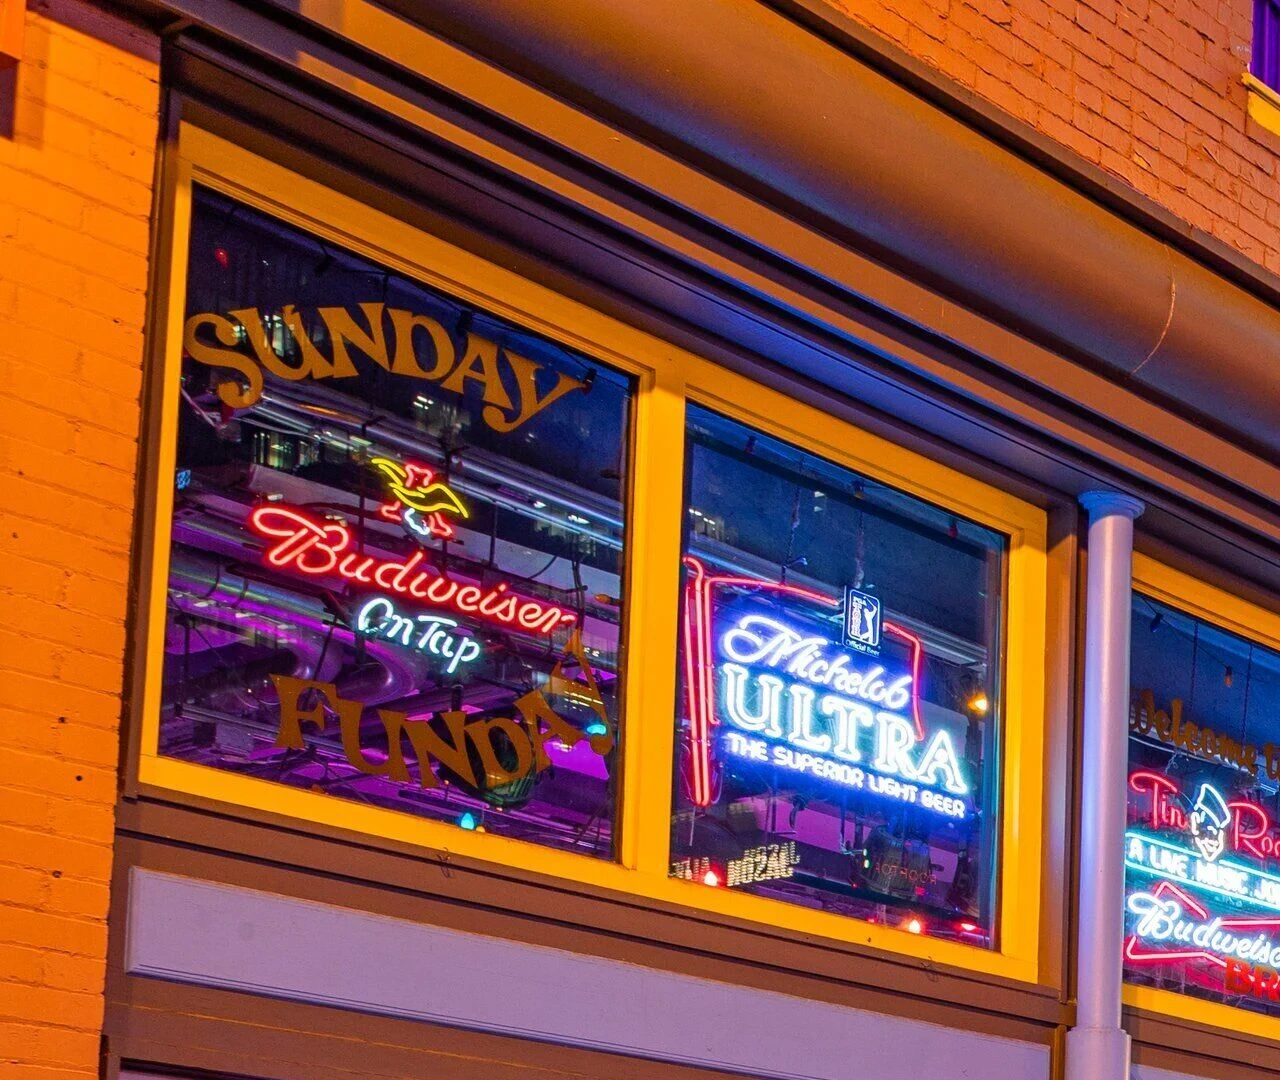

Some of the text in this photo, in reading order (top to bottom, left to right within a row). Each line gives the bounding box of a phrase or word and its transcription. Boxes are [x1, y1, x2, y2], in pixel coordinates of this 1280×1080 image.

[184, 302, 592, 432] SUNDAY
[252, 505, 576, 634] Budweiser
[403, 612, 481, 674] Tap
[723, 615, 912, 709] Michelob
[270, 629, 614, 791] FUNDAY
[722, 663, 969, 794] ULTRA
[728, 732, 967, 819] THE SUPERIOR LIGHT BEER
[1129, 771, 1188, 830] Tin
[1128, 836, 1144, 862] A
[1149, 843, 1188, 880] LIVE
[1194, 860, 1249, 896] MUSIC
